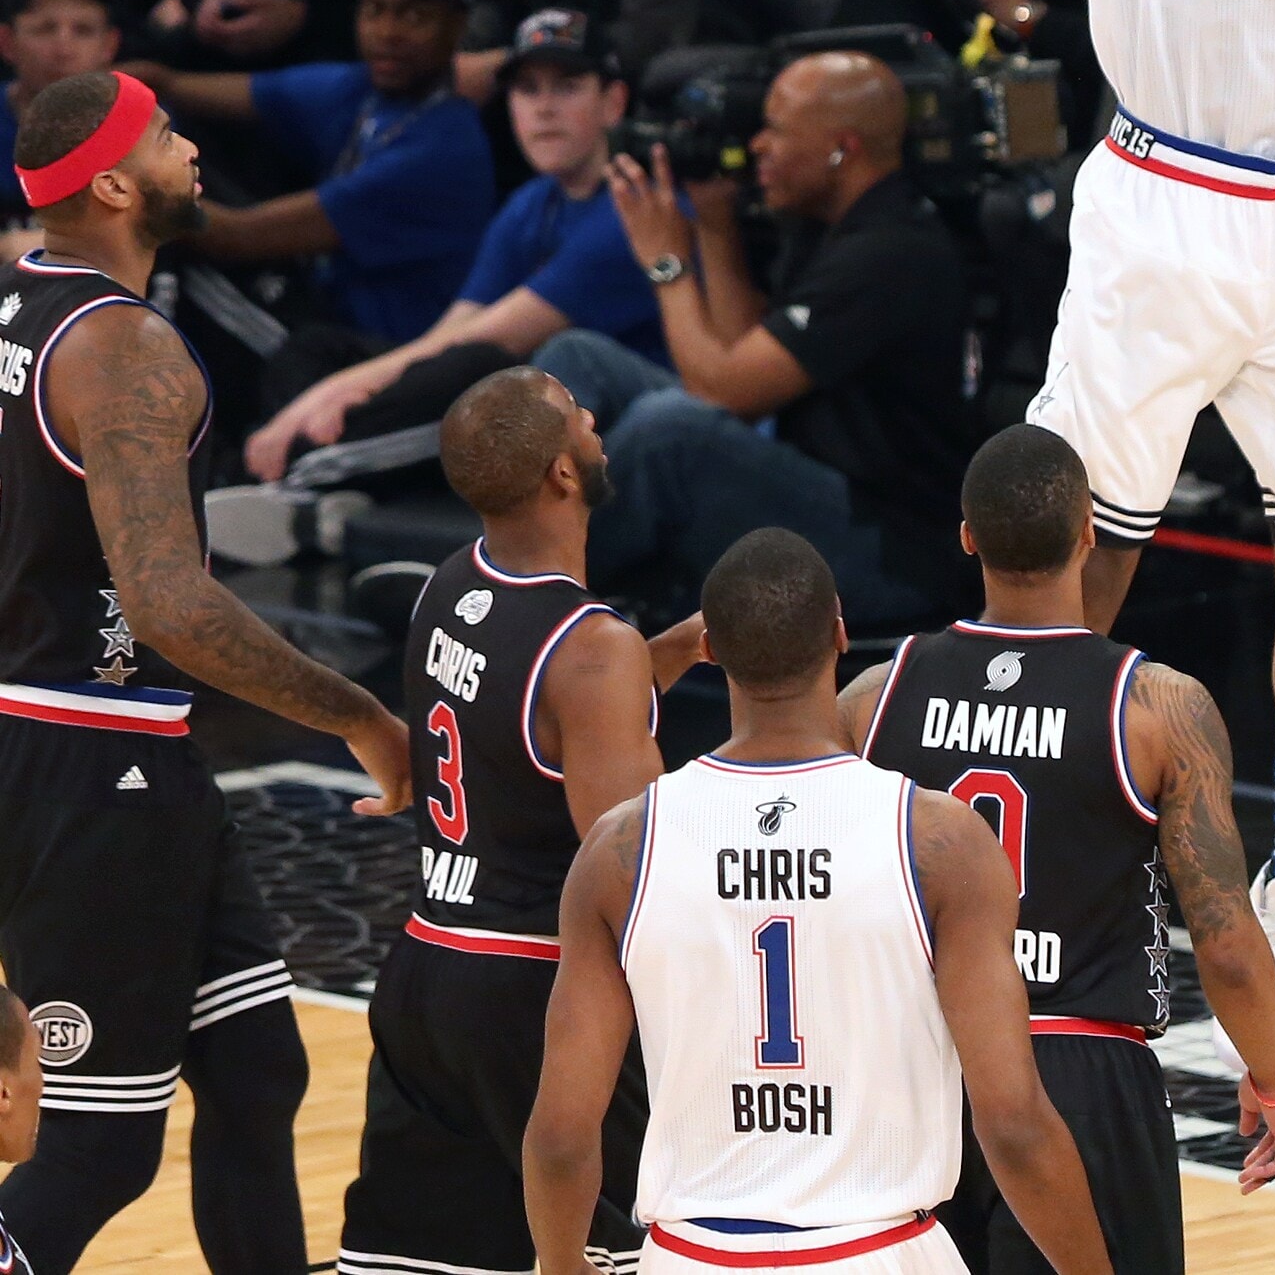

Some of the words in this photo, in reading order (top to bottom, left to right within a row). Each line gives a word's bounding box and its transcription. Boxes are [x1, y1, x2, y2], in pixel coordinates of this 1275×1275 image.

[426, 626, 487, 703] CHRIS
[921, 697, 1067, 759] DAMIAN
[428, 700, 468, 846] 3
[717, 848, 832, 901] CHRIS
[1013, 928, 1062, 984] RD
[752, 914, 806, 1070] 1
[732, 1082, 832, 1136] BOSH
